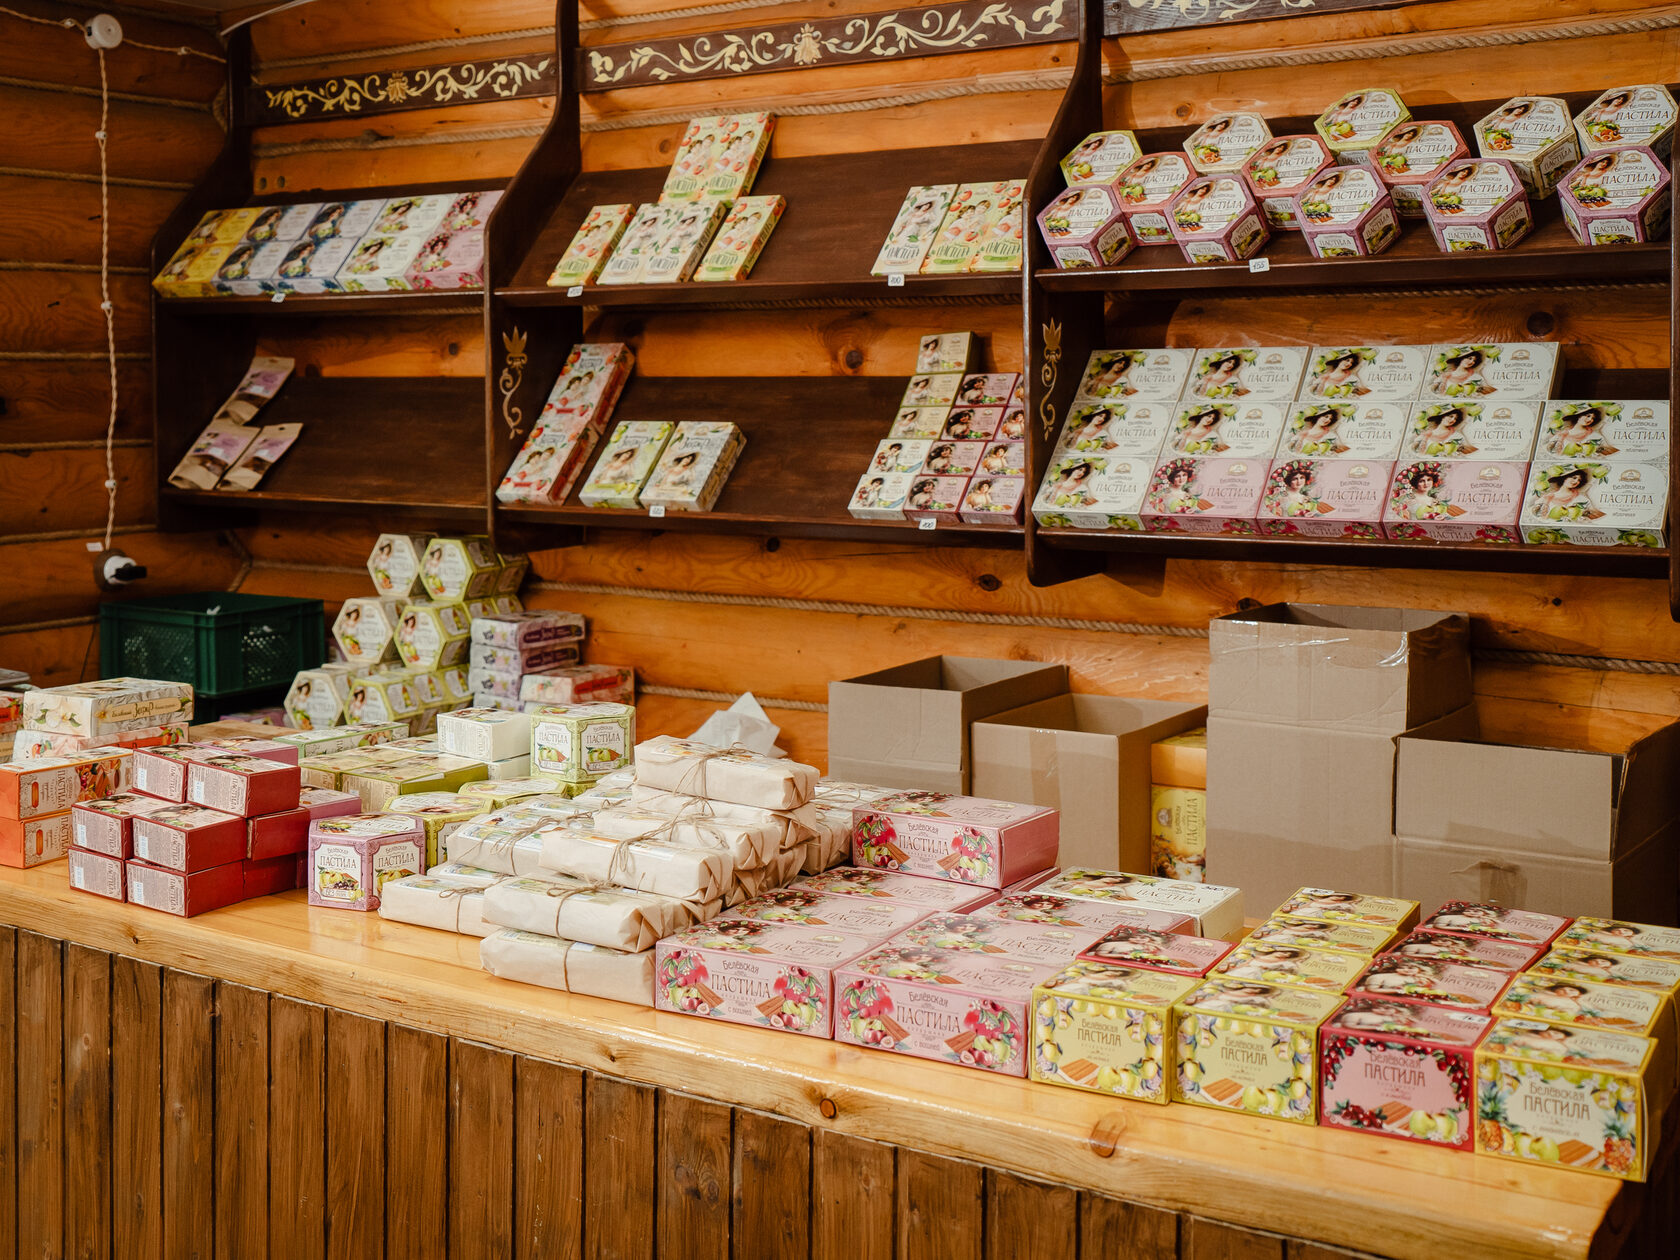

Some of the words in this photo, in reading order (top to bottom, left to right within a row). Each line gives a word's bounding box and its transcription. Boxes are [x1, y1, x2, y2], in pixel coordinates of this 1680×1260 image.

[1351, 110, 1397, 121] ПАСТИЛА
[1616, 110, 1670, 121] ПАСТИЛА
[1511, 122, 1561, 134] ПАСТИЛА
[1405, 144, 1453, 154] ПАСТИЛА
[1601, 174, 1657, 185] ПАСТИЛА
[1458, 184, 1510, 194] ПАСТИЛА
[1492, 370, 1541, 381] ПАСТИЛА
[1473, 430, 1523, 440] ПАСТИЛА
[1612, 431, 1666, 441] ПАСТИЛА
[1457, 493, 1511, 504] ПАСТИЛА
[1599, 493, 1654, 505] ПАСТИЛА
[586, 733, 620, 744] ПАСТИЛА
[57, 770, 66, 809] ПАСТИЛА
[908, 823, 939, 834] Белёвская
[1186, 798, 1198, 846] ПАСТИЛА
[900, 834, 950, 855] ПАСТИЛА
[320, 856, 356, 868] ПАСТИЛА
[378, 853, 415, 868] ПАСТИЛА
[1136, 890, 1201, 904] ПАСТИЛА
[1000, 939, 1076, 957] ПАСТИЛА
[722, 960, 760, 976] Белёвская
[711, 974, 770, 998] ПАСТИЛА
[908, 991, 948, 1008] Белёвская
[896, 1005, 960, 1034] ПАСТИЛА
[1078, 1028, 1122, 1047] ПАСТИЛА
[1221, 1046, 1268, 1066] ПАСТИЛА
[1370, 1052, 1421, 1068] Белёвская
[1364, 1063, 1426, 1087] ПАСТИЛА
[1530, 1082, 1585, 1101] Белёвская
[1524, 1095, 1590, 1120] ПАСТИЛА
